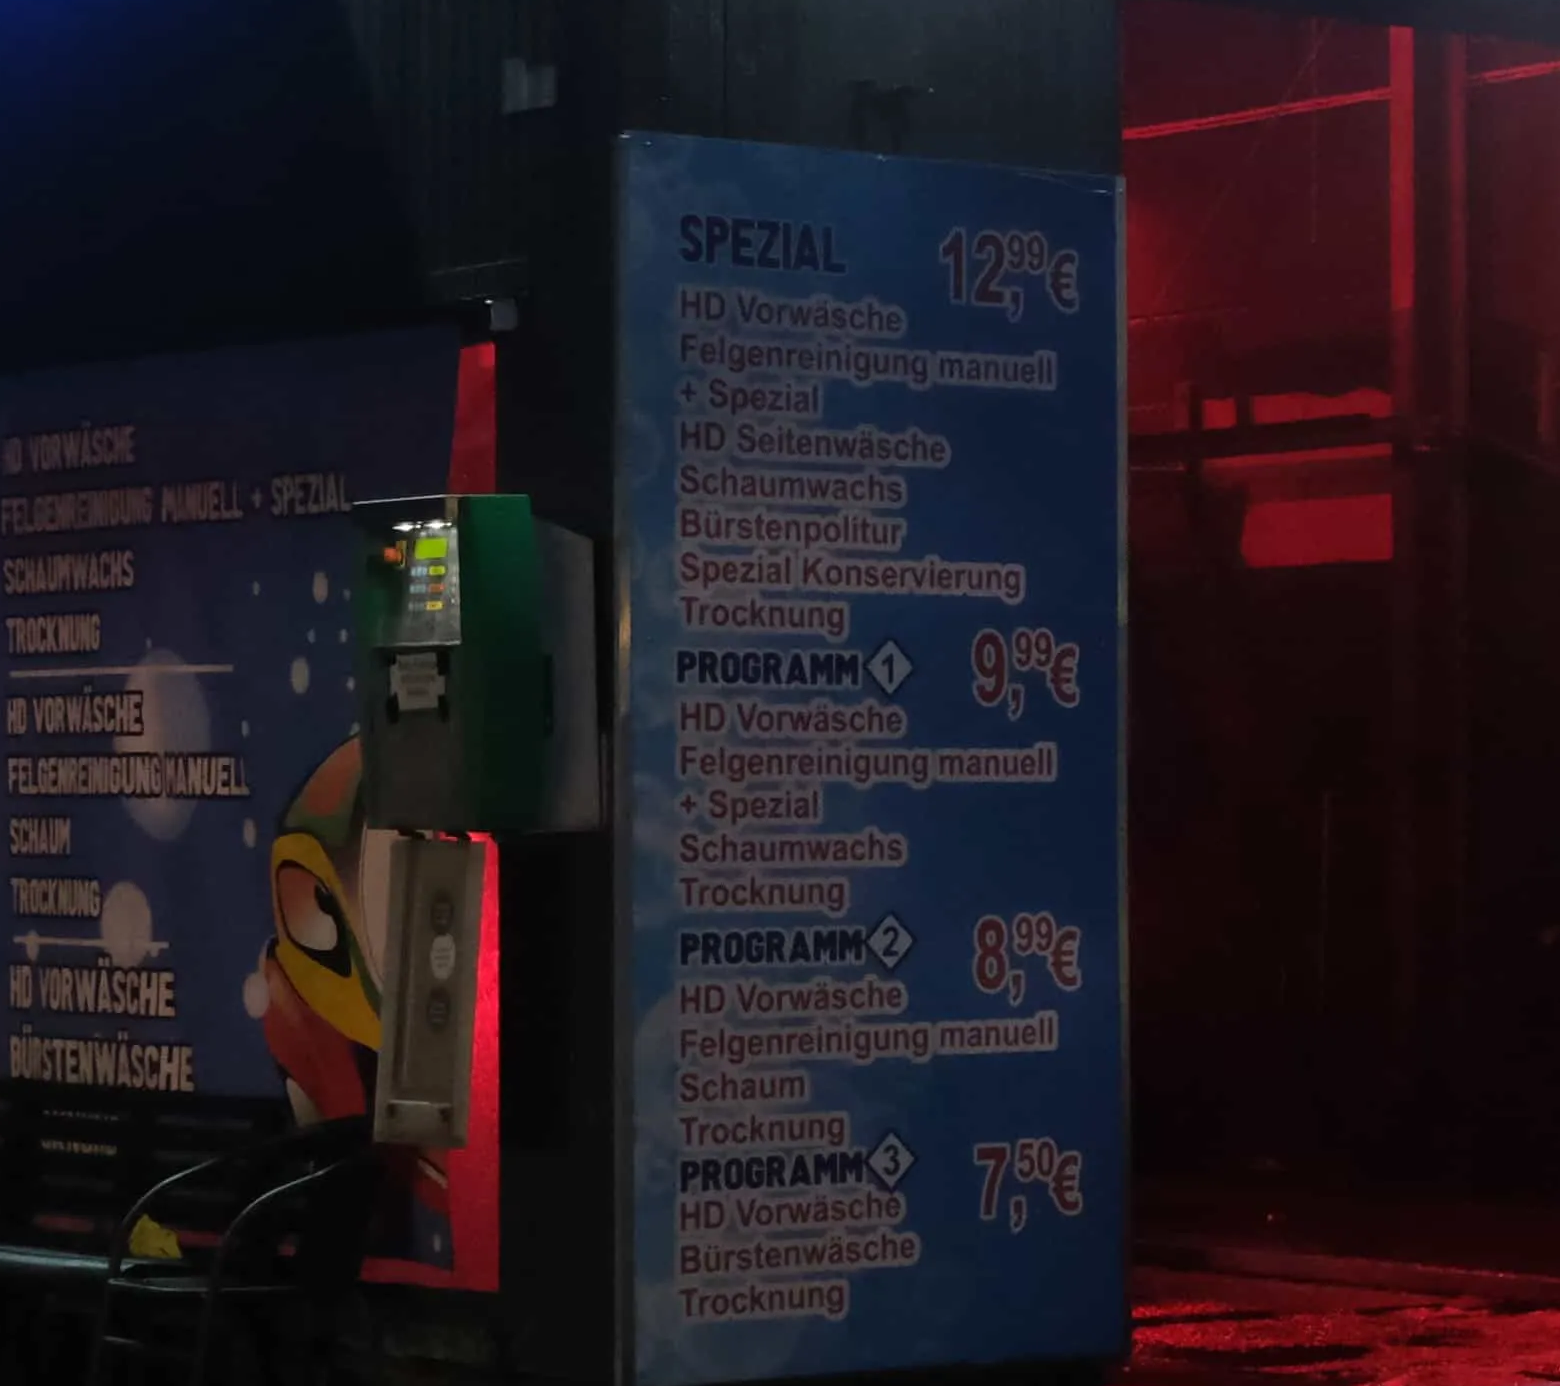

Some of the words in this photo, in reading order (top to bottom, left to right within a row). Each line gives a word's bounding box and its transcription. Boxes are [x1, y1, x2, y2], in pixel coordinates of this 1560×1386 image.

[679, 214, 846, 274] SPEZIAL
[680, 290, 725, 321] HD
[737, 295, 902, 332] Vorwäsche
[680, 334, 928, 384] Felgenreinigung
[940, 355, 1053, 385] manuell
[680, 383, 697, 404] +
[708, 378, 819, 415] Spezial
[680, 421, 725, 452] HD
[738, 424, 946, 462] Seitenwäsche
[161, 479, 244, 524] MANUELL
[270, 471, 352, 517] SPEZIAL
[680, 466, 902, 503] Schaumwachs
[680, 508, 902, 547] Bürstenpolitur
[3, 549, 135, 596] SCHAUMWACHS
[680, 554, 791, 589] Spezial
[802, 559, 1021, 598] Konservierung
[6, 614, 101, 655] TROCKNUNG
[680, 597, 845, 635] Trocknung
[677, 650, 859, 686] PROGRAMM
[881, 654, 896, 683] 1
[7, 697, 28, 735] HD
[32, 685, 143, 734] VORWÄSCHE
[680, 702, 725, 733] HD
[737, 703, 903, 734] Vorwäsche
[8, 754, 163, 796] FELGENREINIGUNG
[165, 756, 251, 797] MANUELL
[680, 746, 929, 784] Felgenreinigung
[940, 747, 1053, 777] manuell
[680, 795, 697, 813] +
[708, 789, 819, 821] Spezial
[9, 816, 72, 855] SCHAUM
[680, 833, 902, 863] Schaumwachs
[10, 877, 102, 918] TROCKNUNG
[680, 877, 845, 911] Trocknung
[679, 929, 864, 965] PROGRAMM
[881, 927, 899, 957] 2
[9, 964, 34, 1010] HD
[39, 957, 176, 1018] VORWÄSCHE
[680, 985, 725, 1014] HD
[737, 979, 902, 1013] Vorwäsche
[9, 1023, 196, 1093] BÜRSTENWÄSCHE
[680, 1025, 929, 1063] Felgenreinigung
[940, 1015, 1054, 1047] manuell
[680, 1073, 806, 1103] Schaum
[680, 1115, 845, 1146] Trocknung
[679, 1152, 864, 1193] PROGRAMM
[882, 1144, 901, 1175] 3
[680, 1201, 725, 1230] HD
[737, 1194, 902, 1229] Vorwäsche
[680, 1234, 916, 1274] Bürstenwäsche
[680, 1284, 845, 1318] Trocknung
